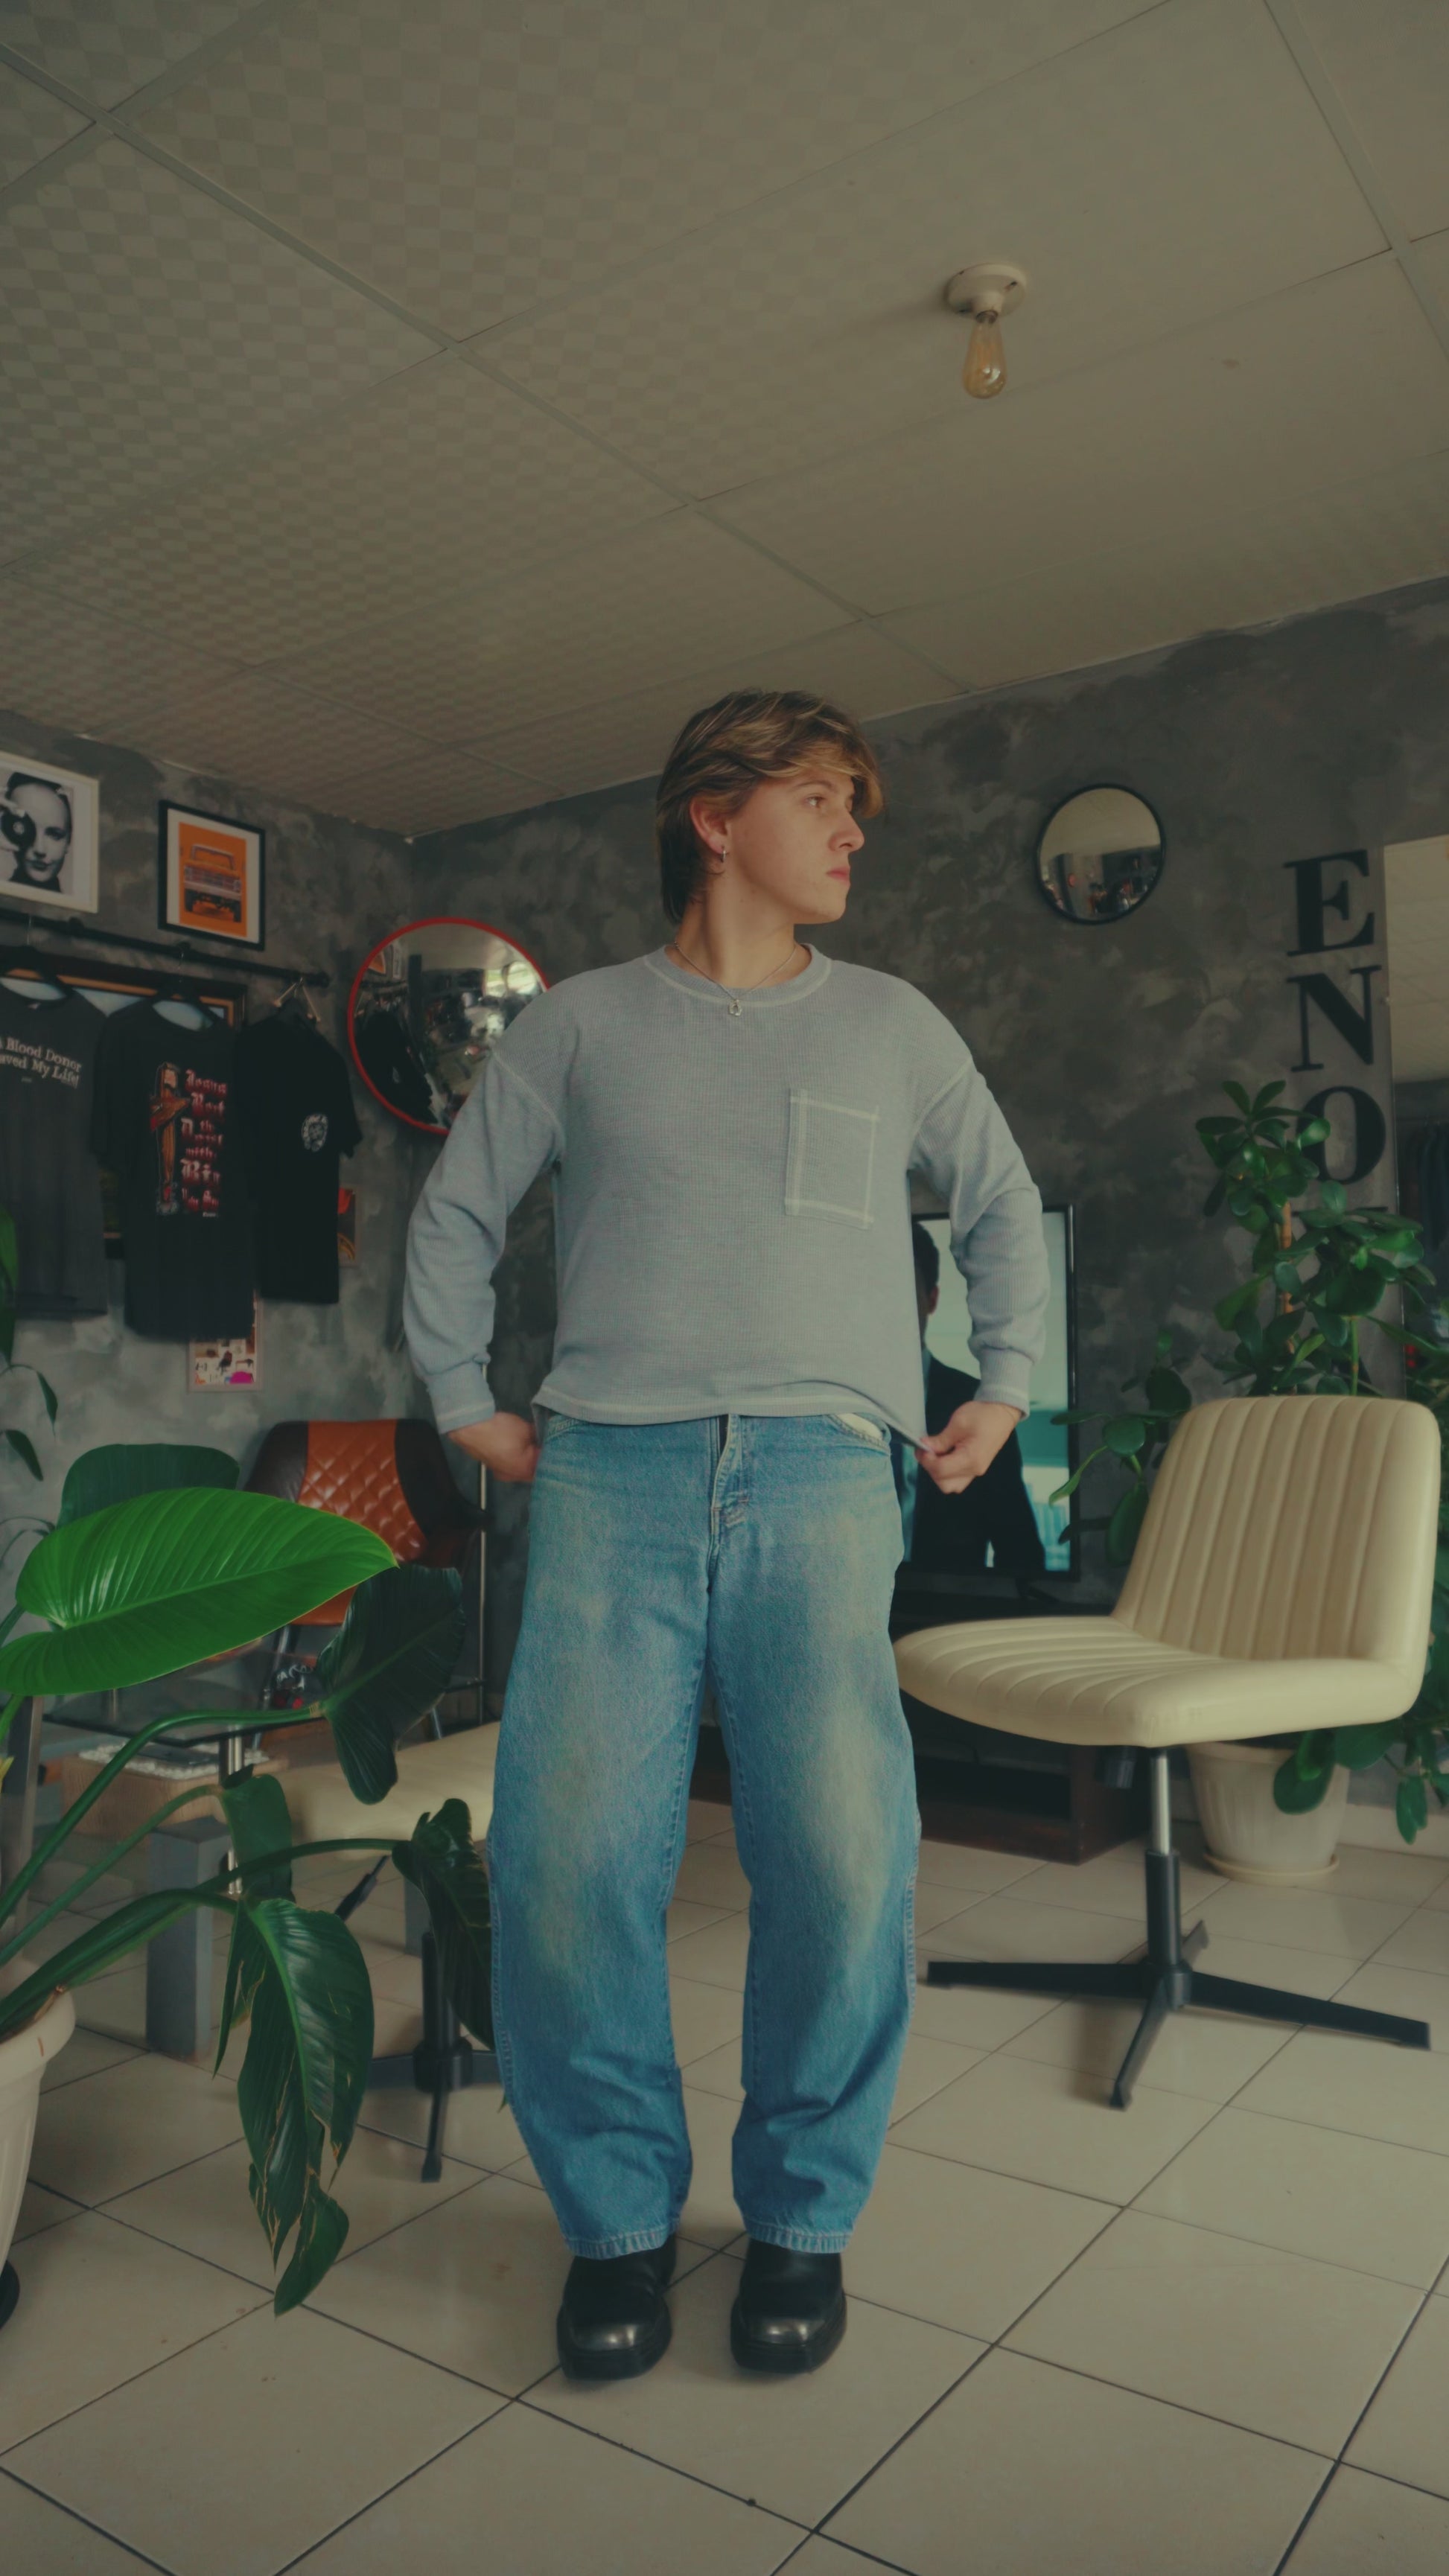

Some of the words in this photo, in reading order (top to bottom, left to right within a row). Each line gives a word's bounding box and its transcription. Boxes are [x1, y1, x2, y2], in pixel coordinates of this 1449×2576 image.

[1282, 849, 1388, 1221] ENO
[0, 1053, 28, 1070] aved
[31, 1058, 50, 1079] My
[6, 1036, 42, 1059] Blood
[45, 1048, 82, 1073] Donor
